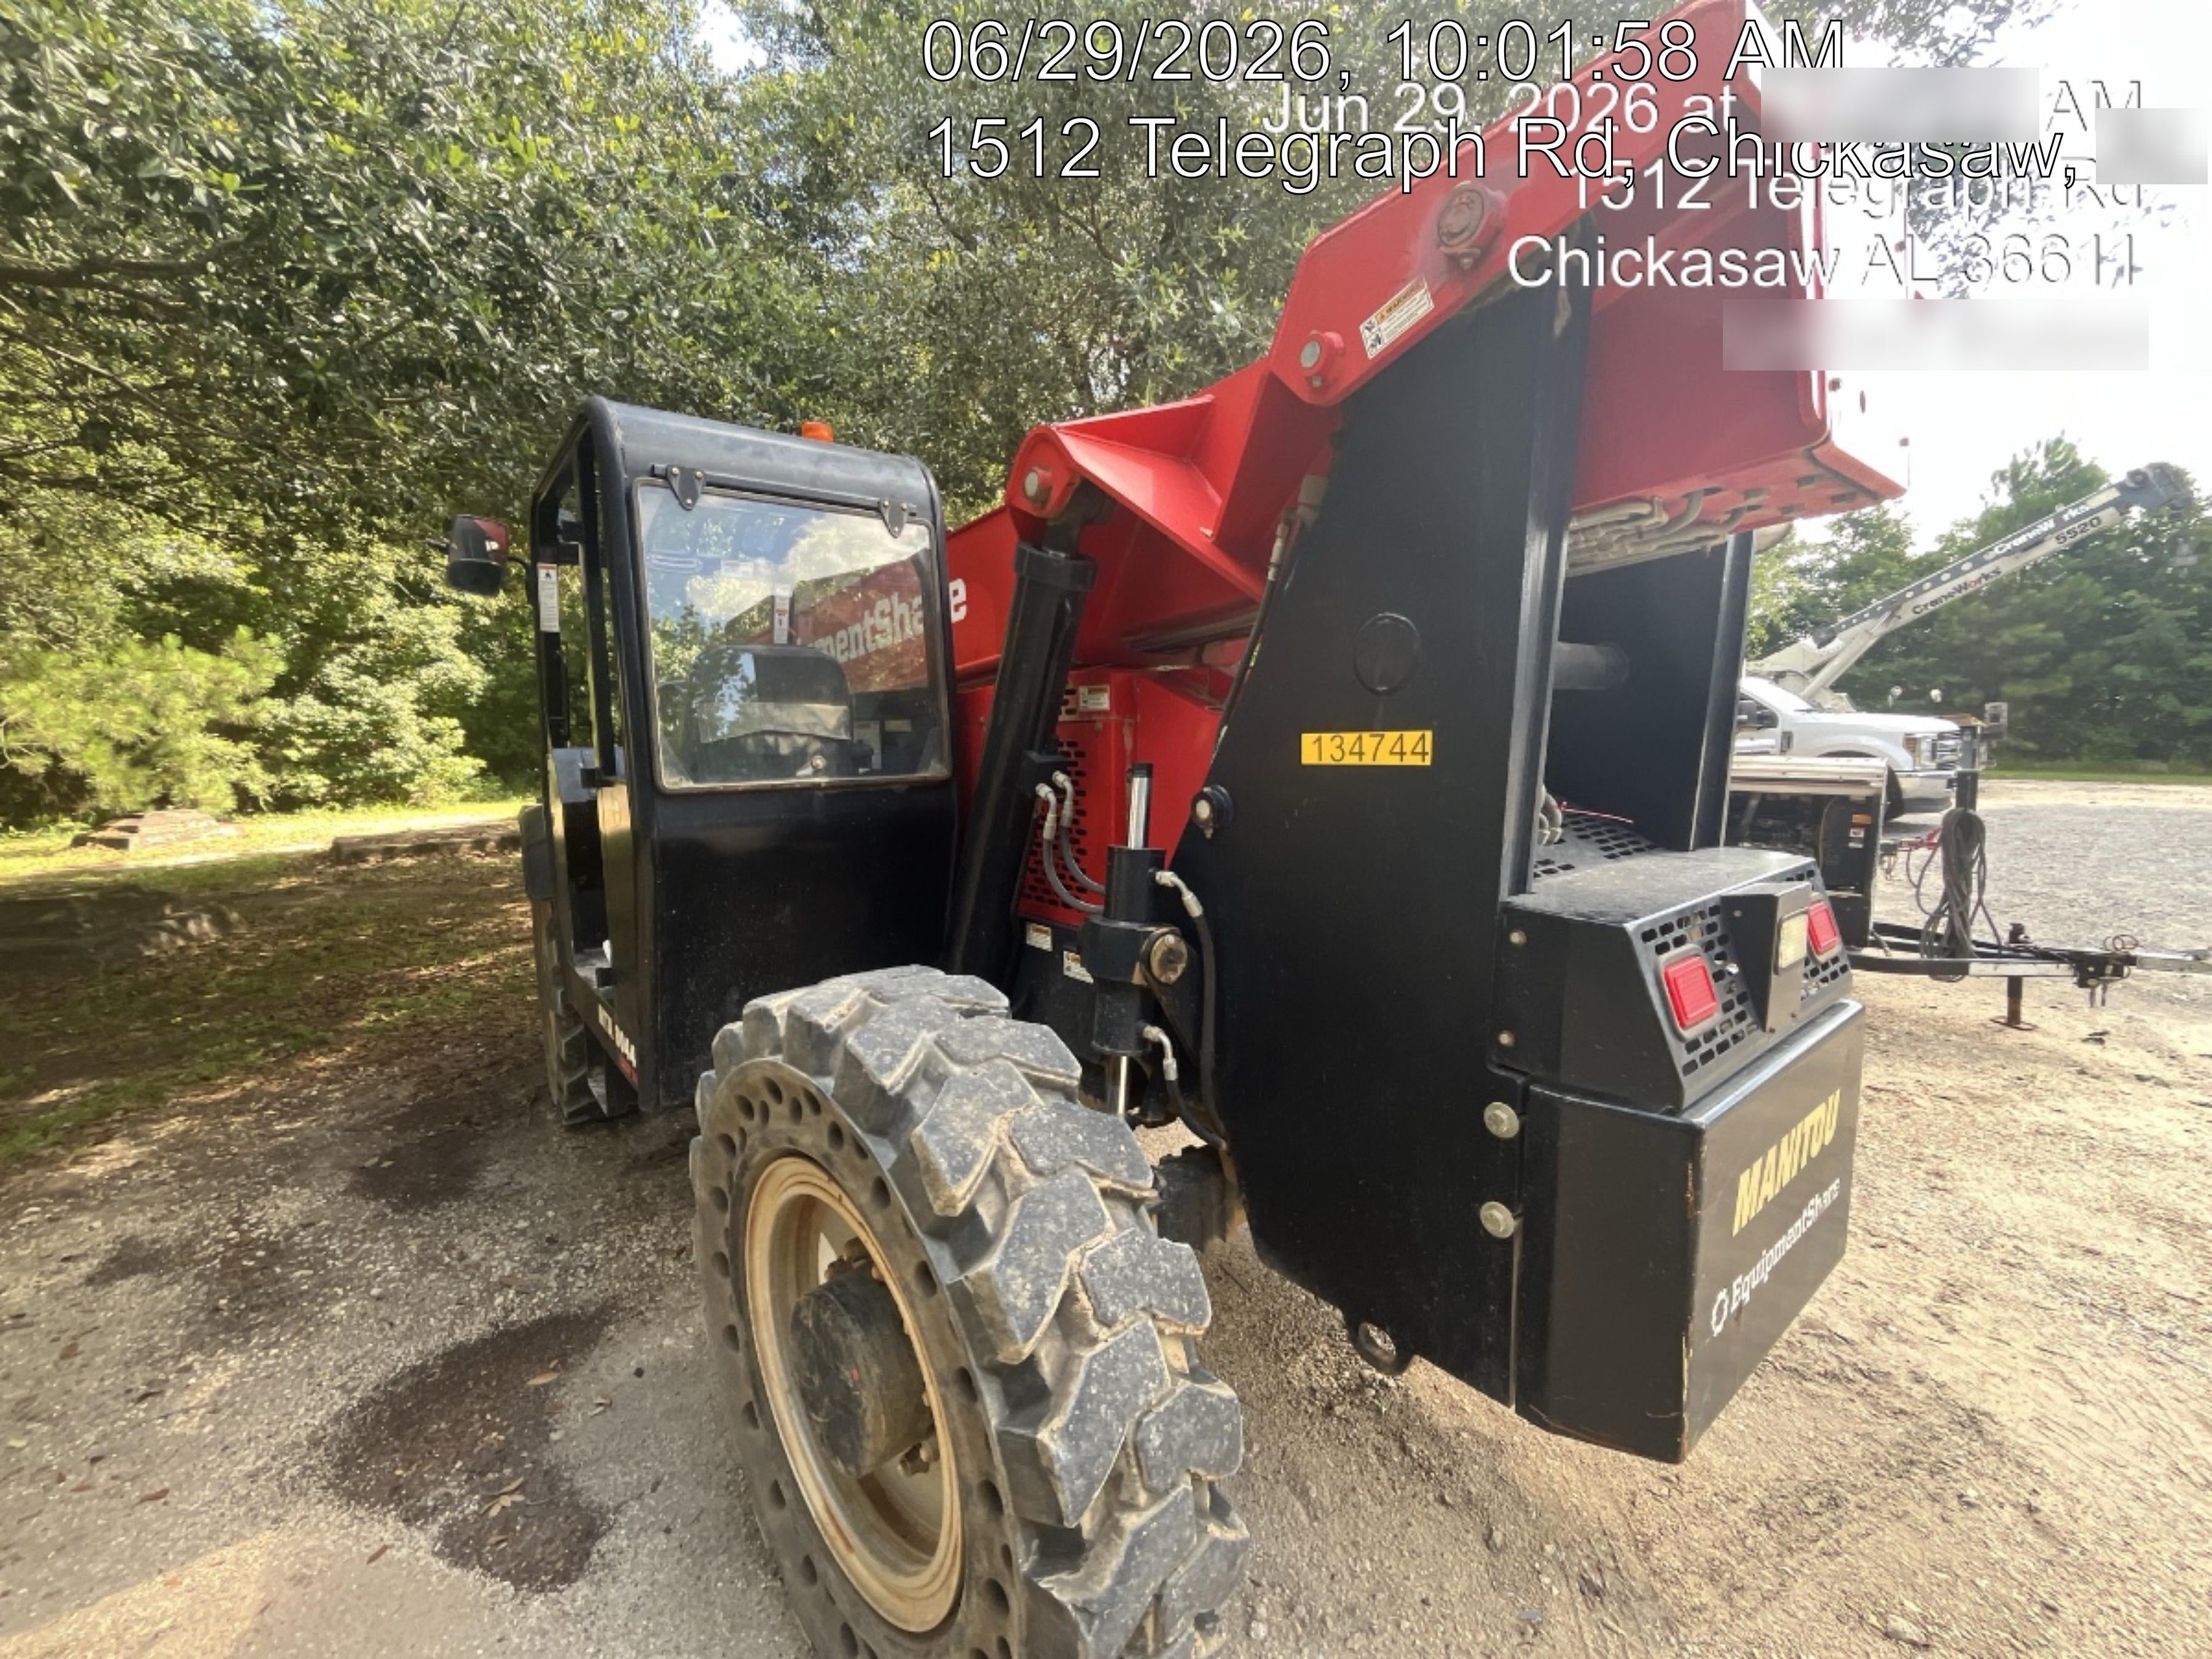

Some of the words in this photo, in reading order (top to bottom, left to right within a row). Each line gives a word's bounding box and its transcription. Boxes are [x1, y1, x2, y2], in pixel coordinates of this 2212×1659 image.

[1312, 732, 1430, 763] 134744
[1732, 1089, 1841, 1237] MANITOU
[1730, 1178, 1841, 1314] EquipmentShare
